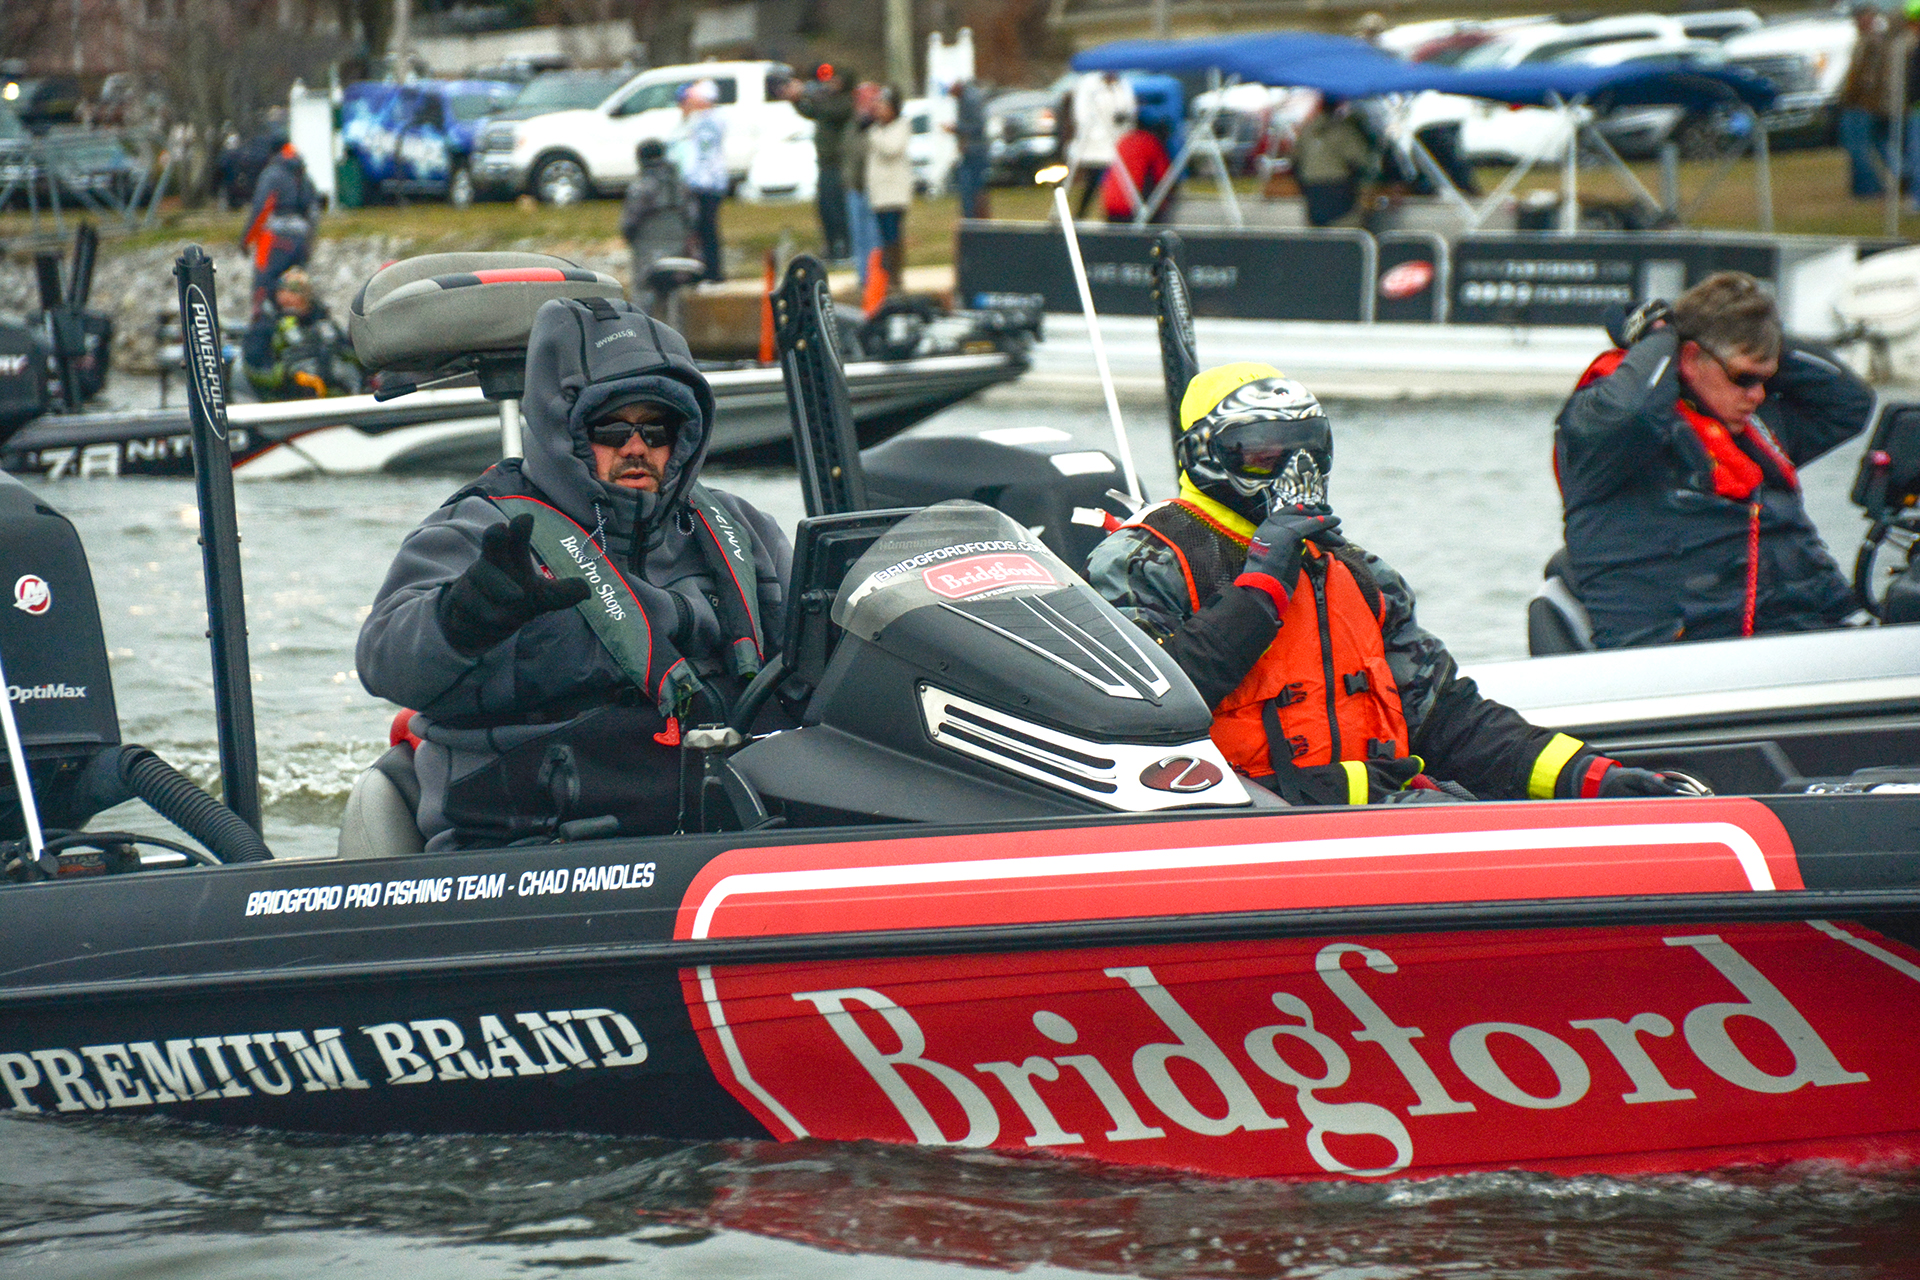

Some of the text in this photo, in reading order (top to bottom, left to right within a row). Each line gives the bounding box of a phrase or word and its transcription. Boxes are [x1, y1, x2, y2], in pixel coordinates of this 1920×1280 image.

[191, 303, 224, 419] POWER-POLE
[560, 535, 627, 621] Bass Pro Shops
[938, 562, 1042, 590] Bridgford
[7, 683, 87, 704] OptiMax
[245, 885, 344, 916] BRIDGFORD
[344, 882, 383, 909] PRO
[383, 876, 454, 906] FISHING
[456, 873, 507, 901] TEAM
[518, 868, 570, 897] CHAD
[571, 862, 656, 893] RANDLES
[0, 1008, 649, 1115] PREMIUM BRAND
[793, 933, 1869, 1176] Bridgford
